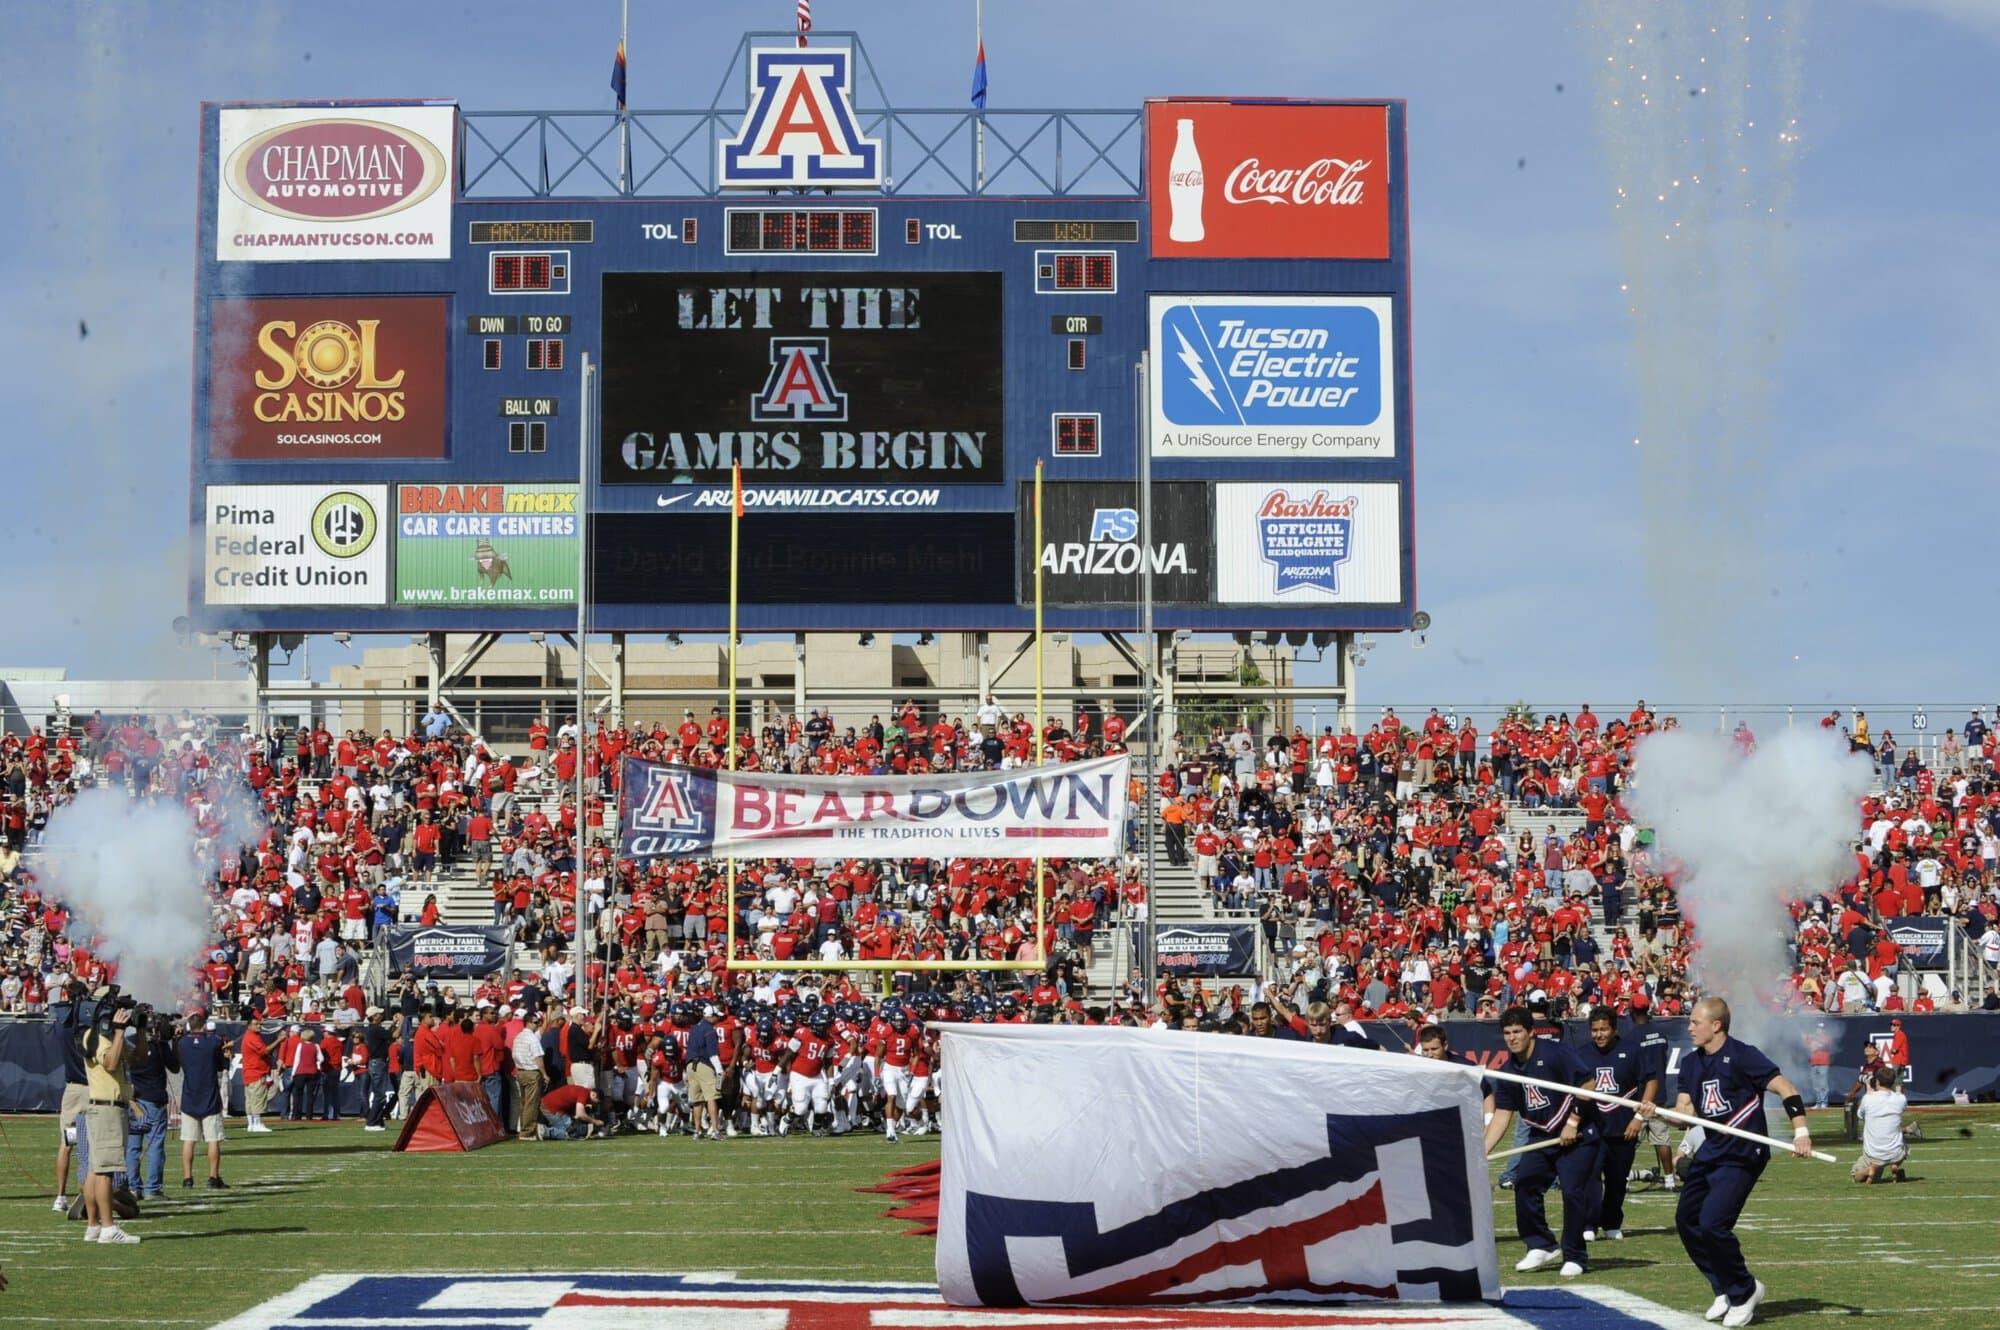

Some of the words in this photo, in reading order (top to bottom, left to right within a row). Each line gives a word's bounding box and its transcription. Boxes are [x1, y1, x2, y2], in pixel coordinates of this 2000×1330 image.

[262, 144, 406, 183] CHAPMAN
[266, 183, 403, 198] AUTOMOTIVE
[1224, 158, 1372, 206] Coca-Cola
[233, 232, 434, 247] CHAPMANTUCSON.COM
[489, 223, 574, 241] ARIZONA
[641, 224, 678, 240] TOL
[763, 213, 873, 249] 4:59
[925, 224, 962, 240] TOL
[1055, 223, 1094, 241] WSU
[677, 288, 782, 330] LET
[800, 288, 921, 330] THE
[479, 317, 505, 333] DWN
[528, 317, 543, 333] TO
[546, 317, 563, 333] GO
[1066, 317, 1088, 333] QTR
[1217, 319, 1330, 350] Tucson
[255, 318, 406, 390] SOL
[1229, 350, 1360, 378] Electric
[1242, 379, 1360, 408] Power
[253, 391, 406, 424] CASINOS
[505, 400, 531, 415] BALL
[535, 400, 551, 415] ON
[276, 433, 382, 446] SOLCASINOS.COM
[1161, 433, 1174, 447] A
[1178, 433, 1254, 447] UniSource
[1257, 433, 1308, 449] Energy
[1312, 433, 1382, 449] Company
[621, 431, 802, 471] GAMES
[820, 431, 988, 471] BEGIN
[399, 486, 505, 514] BRAKE
[504, 492, 579, 514] max
[693, 489, 941, 507] ARIZONAWILDCATS.COM
[1260, 492, 1355, 517] Bashas'
[215, 504, 275, 525] Pima
[402, 516, 439, 536] CAR
[445, 516, 491, 536] CARE
[497, 516, 575, 536] CENTERS
[1090, 508, 1140, 542] FS
[1266, 523, 1345, 535] OFFICIAL
[215, 534, 305, 556] Federal
[1266, 536, 1345, 548] TAILGATE
[1033, 543, 1189, 575] ARIZONA
[1267, 548, 1344, 557] HEADQUARTERS
[214, 566, 289, 587] Credit
[295, 566, 368, 586] Union
[1280, 566, 1332, 576] ARIZONA
[402, 586, 575, 602] www.brakemax.com
[1914, 714, 1927, 729] 30
[839, 828, 865, 839] THE
[872, 827, 954, 839] TRADITION
[960, 826, 1000, 839] LIVES
[414, 938, 455, 946] AMERICAN
[456, 938, 485, 946] FAMILY
[1158, 937, 1199, 946] AMERICAN
[1201, 937, 1229, 945] FAMILY
[615, 1034, 633, 1050] 46
[807, 1041, 826, 1060] 54
[895, 1038, 905, 1056] 2
